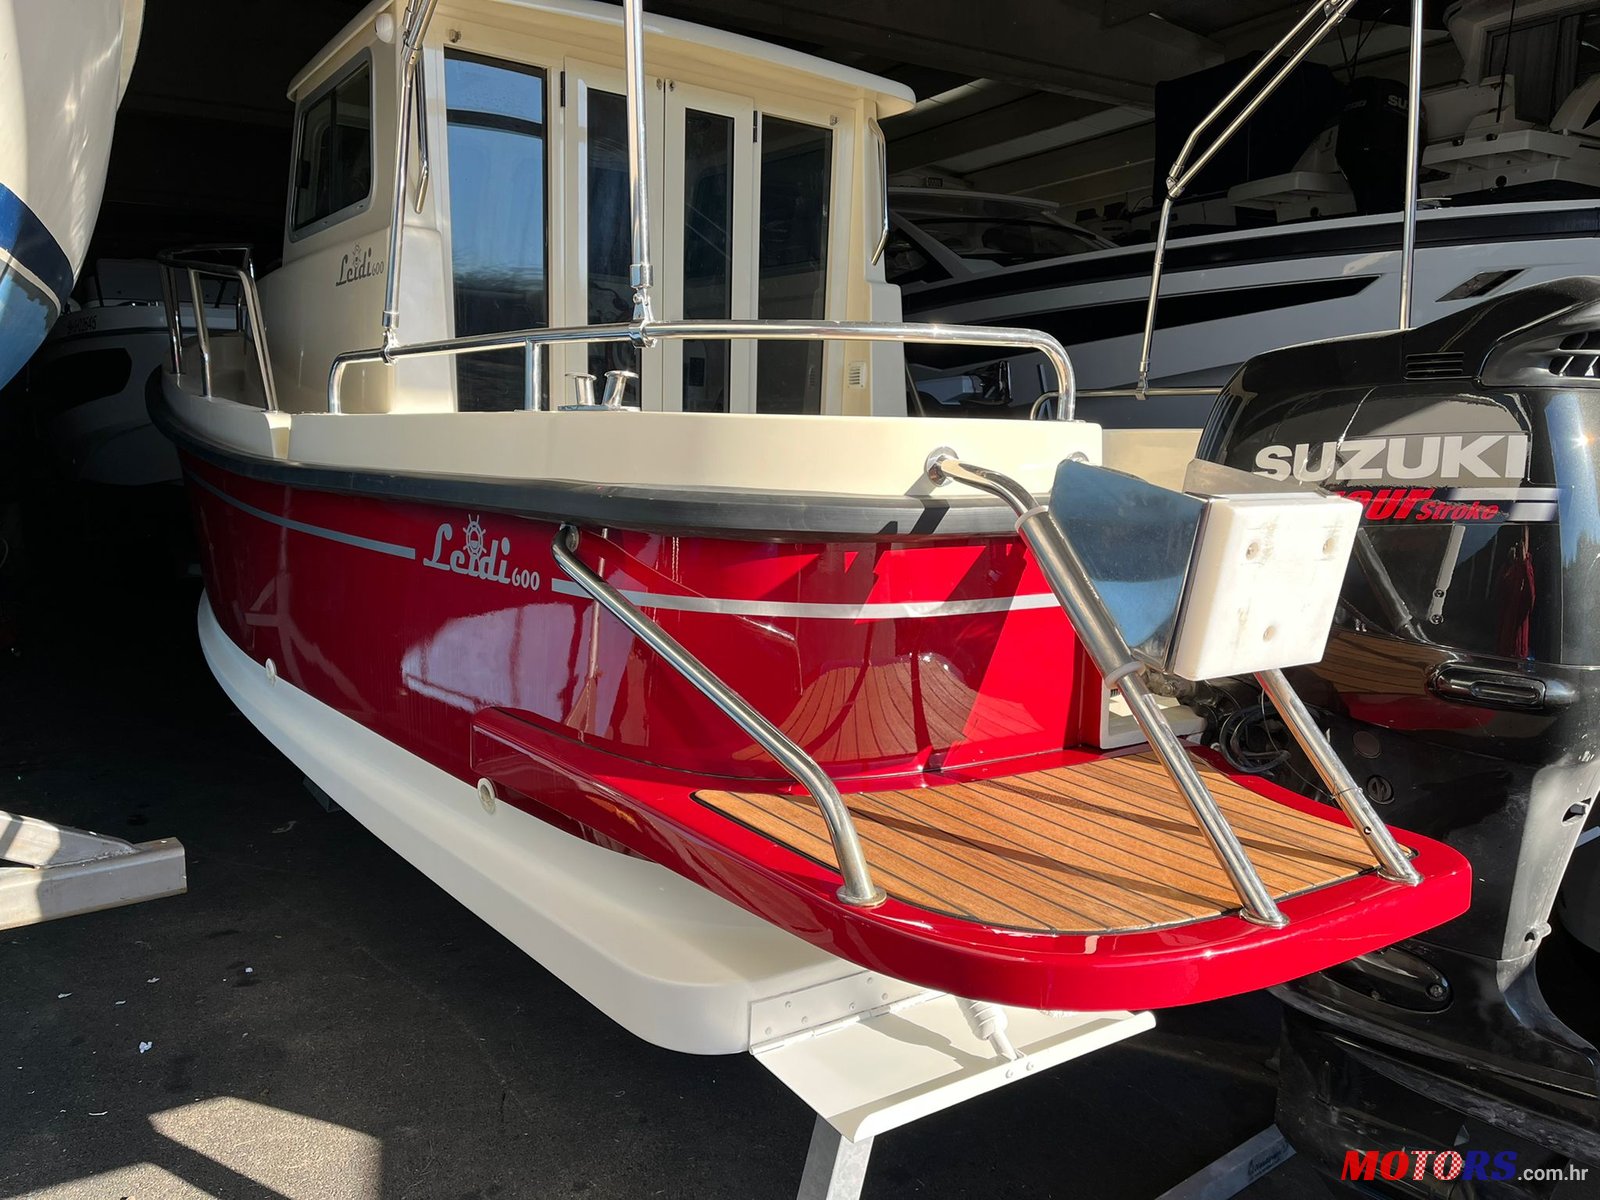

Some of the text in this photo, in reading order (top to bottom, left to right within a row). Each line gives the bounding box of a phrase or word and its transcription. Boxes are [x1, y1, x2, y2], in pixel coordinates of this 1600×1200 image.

[335, 246, 385, 287] Leidi 600
[1252, 434, 1529, 482] SUZUKI
[1416, 501, 1499, 521] Stroke
[423, 516, 540, 591] Leidi 600
